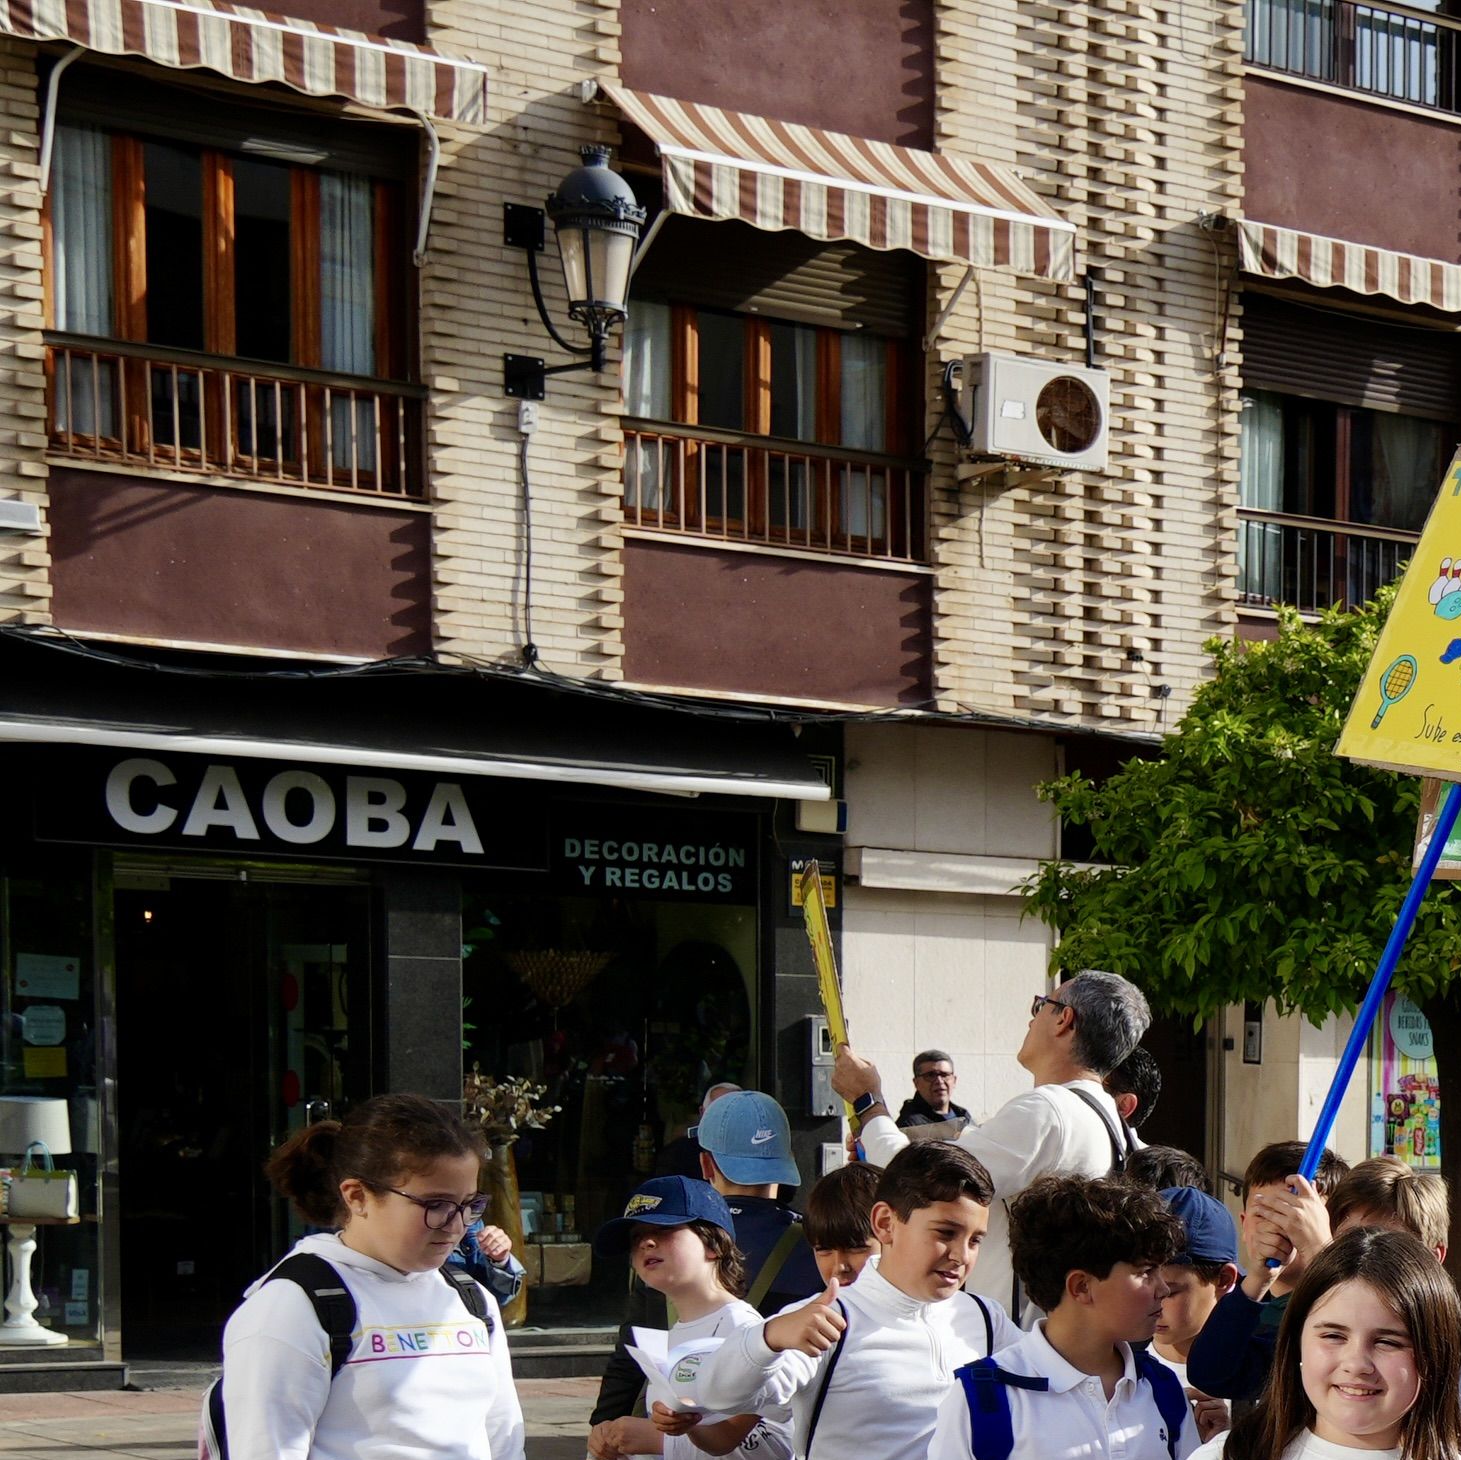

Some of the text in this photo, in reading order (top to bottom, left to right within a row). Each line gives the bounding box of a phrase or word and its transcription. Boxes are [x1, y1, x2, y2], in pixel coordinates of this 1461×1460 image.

[1415, 704, 1447, 743] Sube
[105, 758, 485, 855] CAOBA
[565, 837, 746, 870] DECORACIÓN
[579, 864, 733, 894] Y REGALOS
[755, 1129, 773, 1138] NIKE
[371, 1330, 486, 1353] BENETTON
